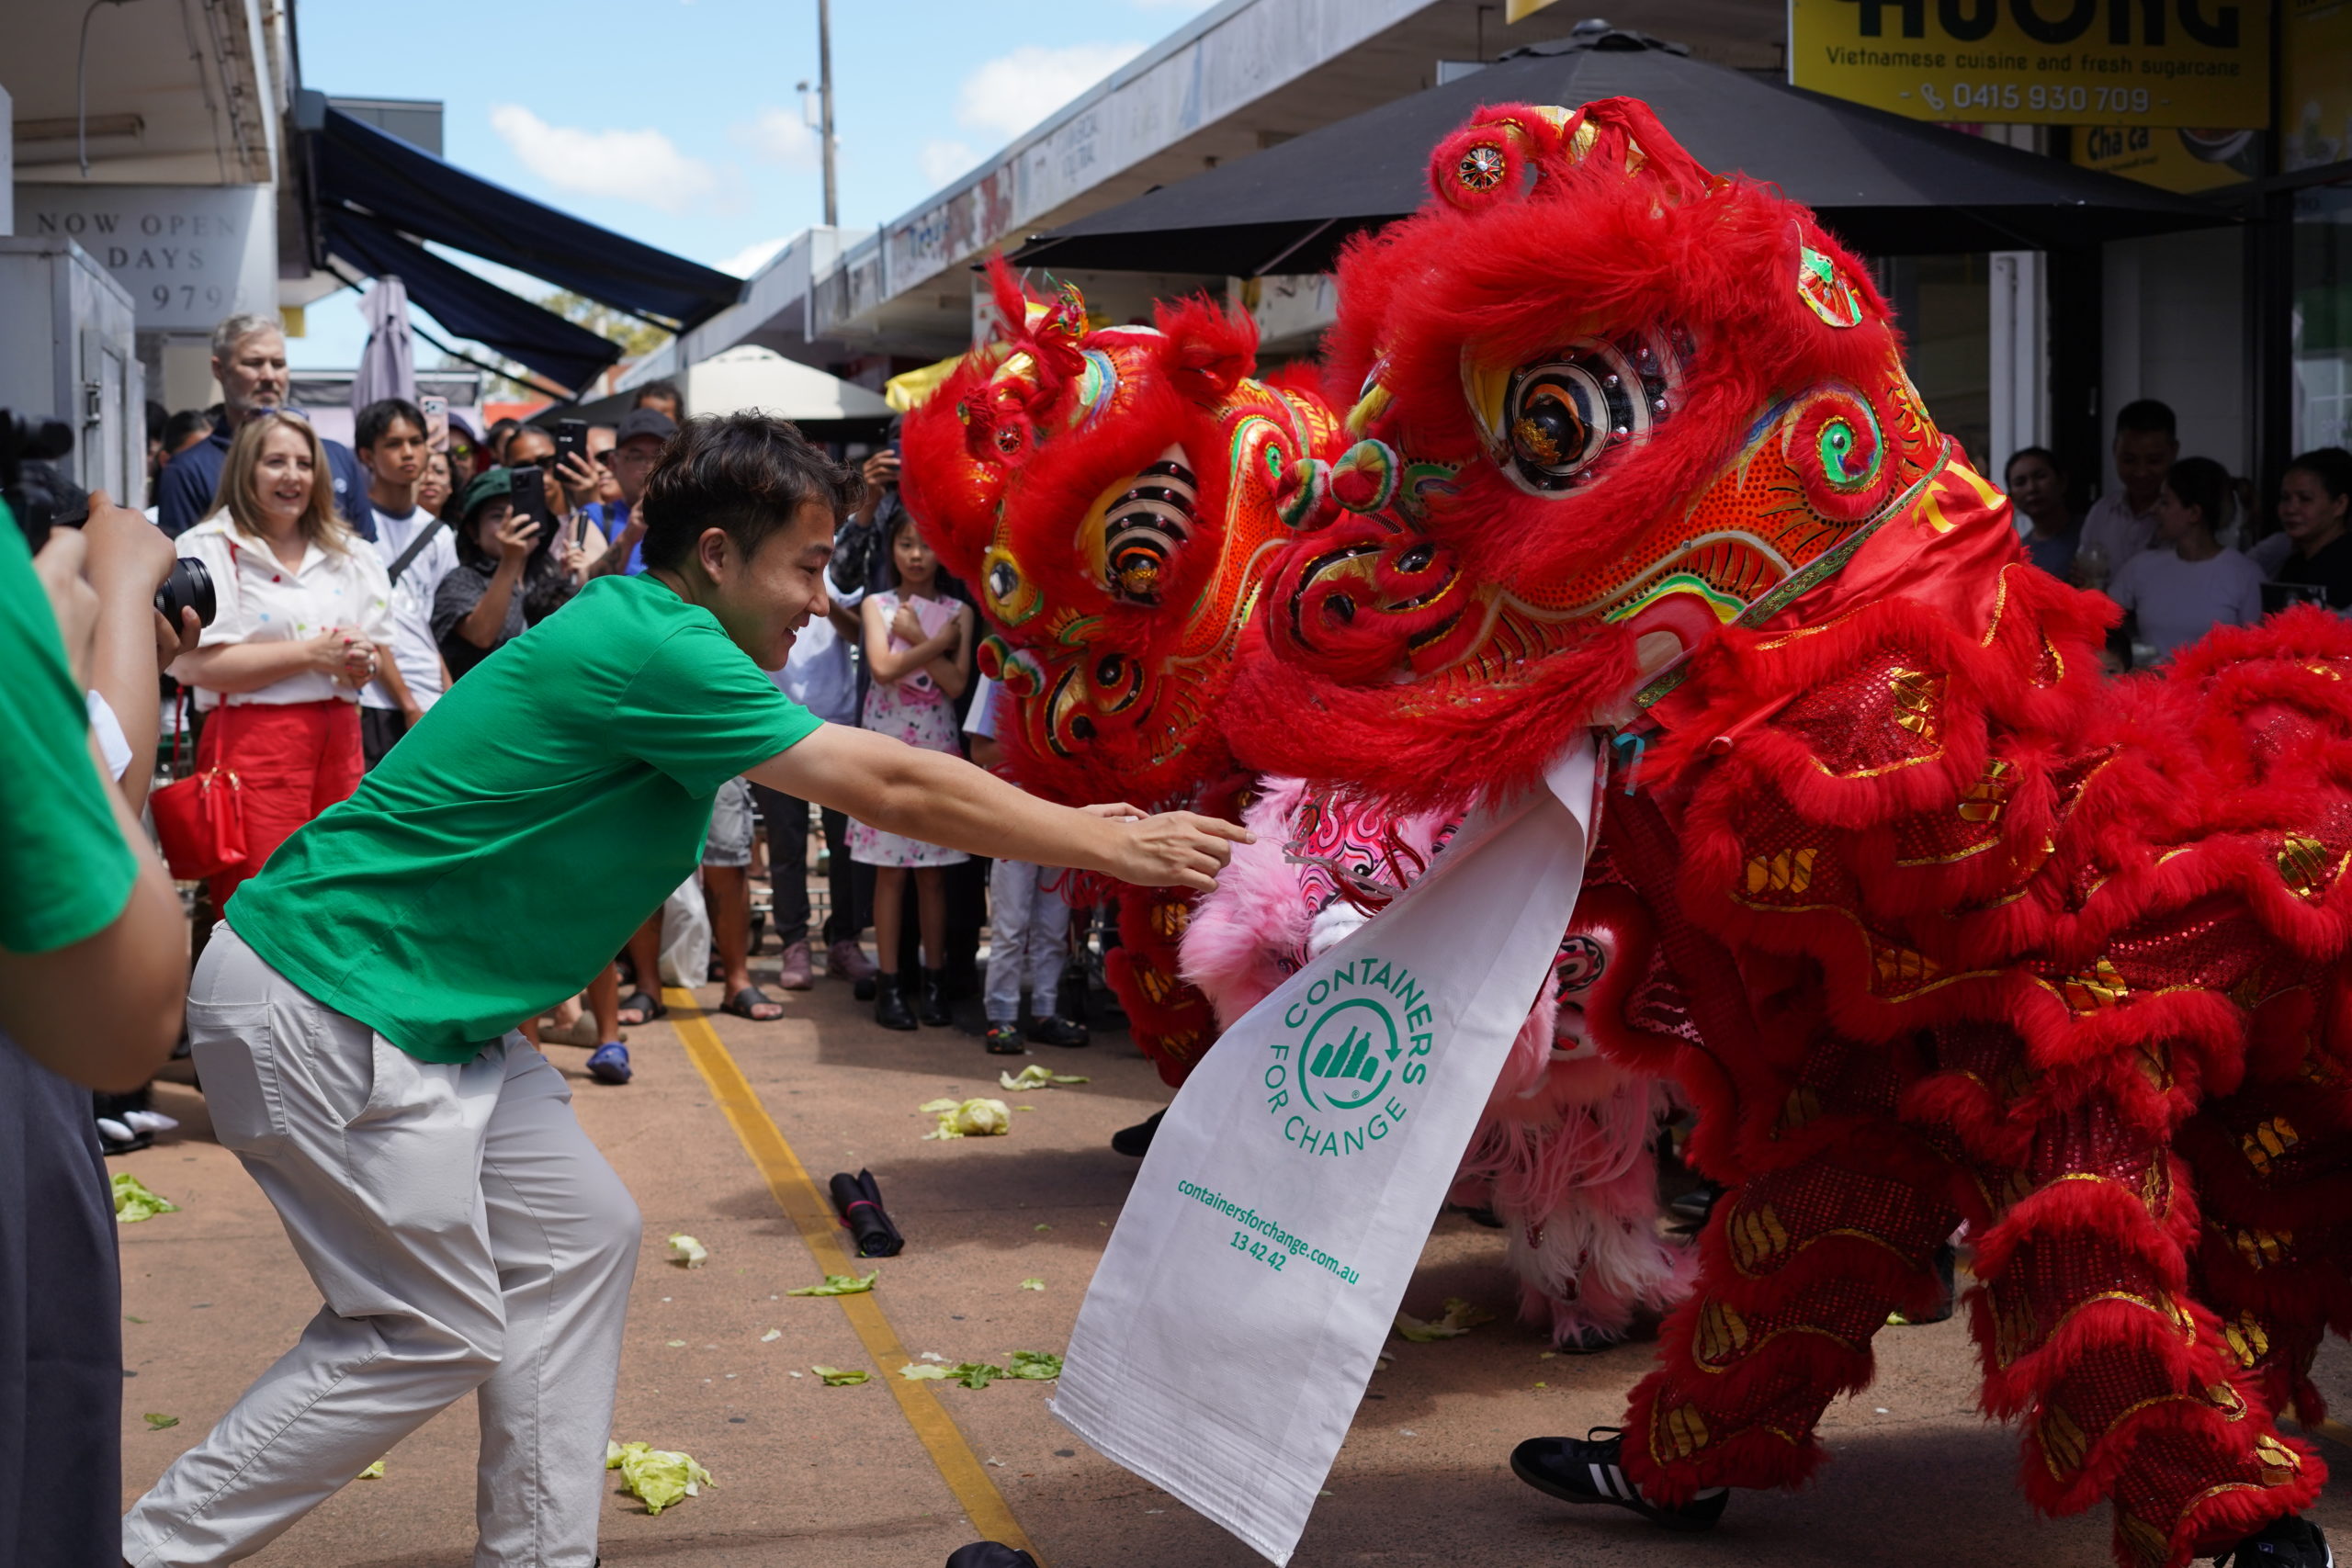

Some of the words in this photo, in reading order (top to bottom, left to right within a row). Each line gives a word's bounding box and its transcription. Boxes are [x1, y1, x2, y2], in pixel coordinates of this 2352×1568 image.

[1826, 46, 1946, 69] Vietnamese
[1955, 52, 2028, 71] cuisine
[2036, 54, 2072, 73] and
[2081, 53, 2132, 74] fresh
[2141, 59, 2240, 79] sugarcane
[1953, 83, 2020, 110] 0415
[2029, 85, 2087, 111] 930
[2095, 86, 2151, 113] 709
[37, 212, 119, 235] NOW
[140, 213, 236, 237] OPEN
[107, 246, 204, 270] DAYS
[1284, 958, 1433, 1086] CONTAINERS
[1265, 1044, 1290, 1114] FOR
[1284, 1095, 1408, 1156] CHANGE
[1178, 1179, 1360, 1285] containersforchange.com.au
[1230, 1231, 1250, 1251] 13
[1249, 1242, 1268, 1262] 42
[1267, 1252, 1287, 1272] 42
